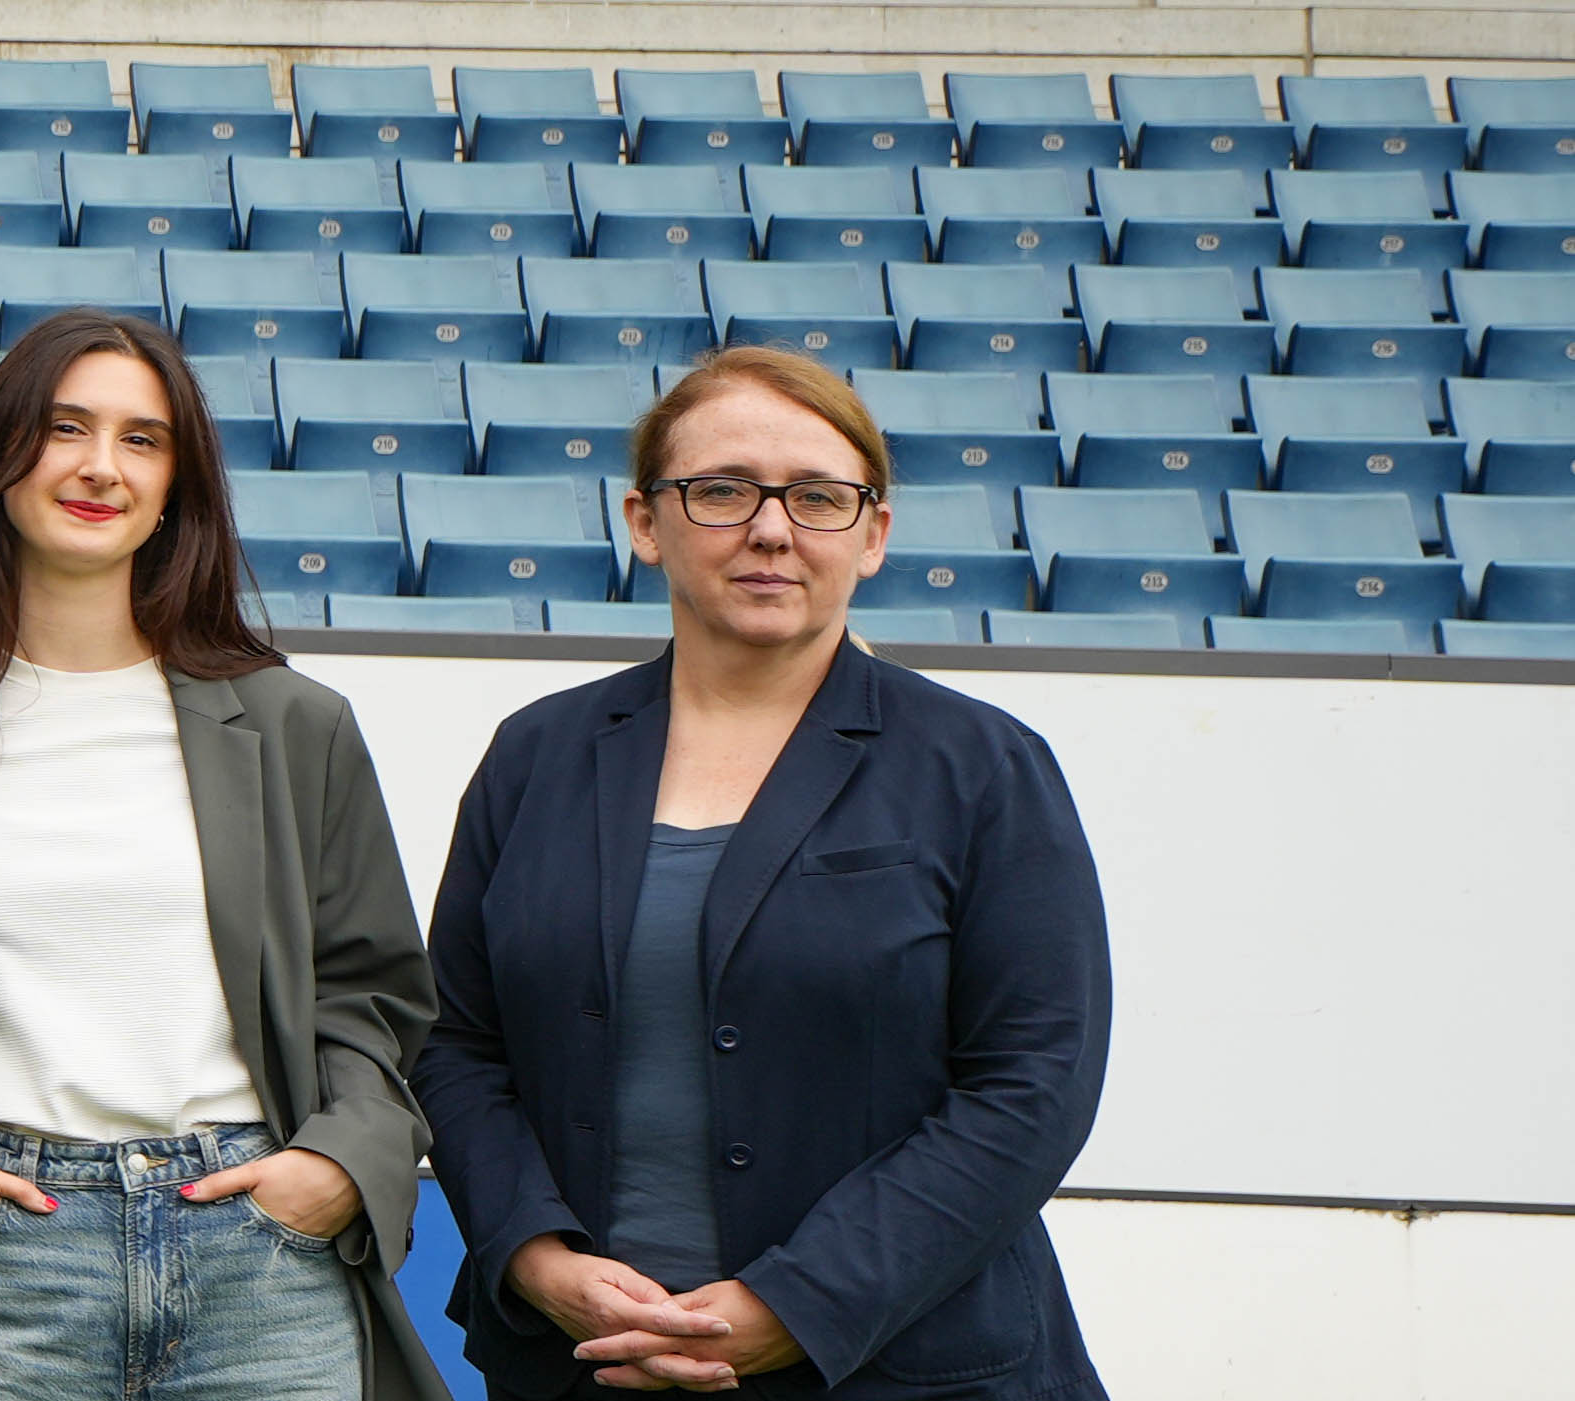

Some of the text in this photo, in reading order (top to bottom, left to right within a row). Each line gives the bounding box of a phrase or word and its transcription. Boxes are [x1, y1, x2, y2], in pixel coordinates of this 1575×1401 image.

[152, 220, 166, 231] 210
[322, 222, 337, 235] 211
[844, 232, 859, 243] 214
[258, 323, 274, 335] 210
[440, 327, 456, 338] 211
[622, 330, 638, 343] 212
[808, 334, 824, 346] 213
[994, 337, 1010, 348] 214
[377, 438, 394, 450] 210
[570, 442, 587, 455] 211
[966, 451, 984, 462] 213
[1167, 454, 1185, 466] 214
[303, 557, 321, 569] 209
[514, 561, 532, 574] 210
[932, 571, 950, 583] 212
[1145, 575, 1164, 588] 213
[1361, 580, 1380, 593] 214
